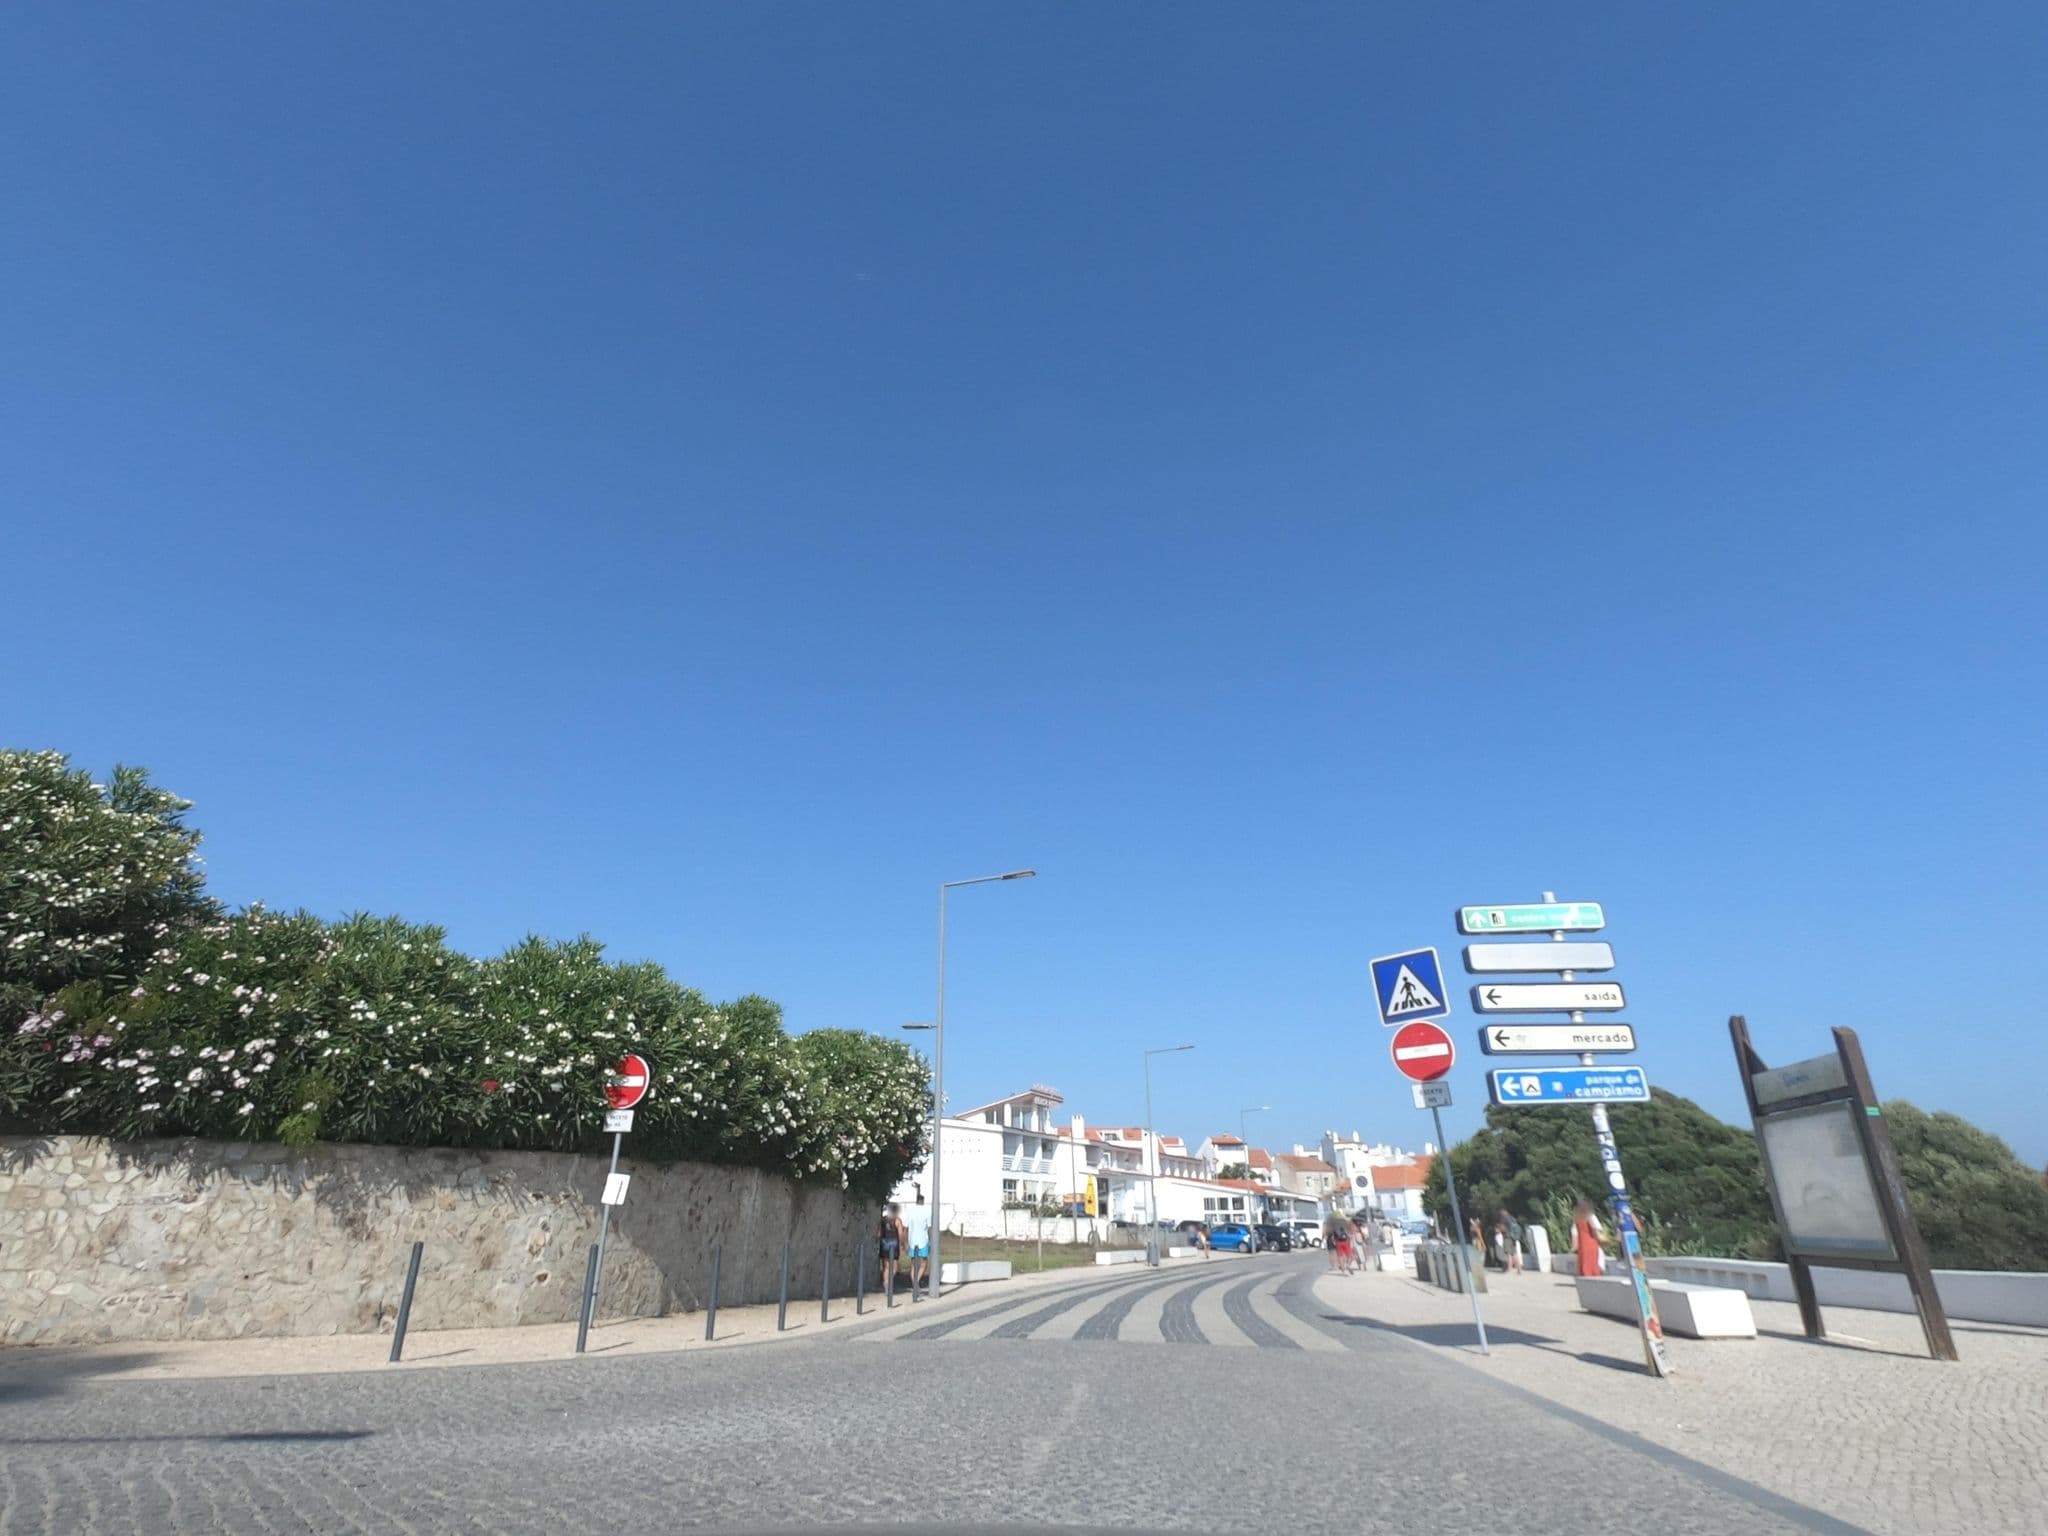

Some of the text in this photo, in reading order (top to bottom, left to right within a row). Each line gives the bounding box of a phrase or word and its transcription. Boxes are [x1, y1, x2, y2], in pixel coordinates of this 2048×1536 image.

[1572, 1033, 1628, 1043] mercado
[1585, 1072, 1639, 1087] parque de
[1574, 1084, 1642, 1098] campismo
